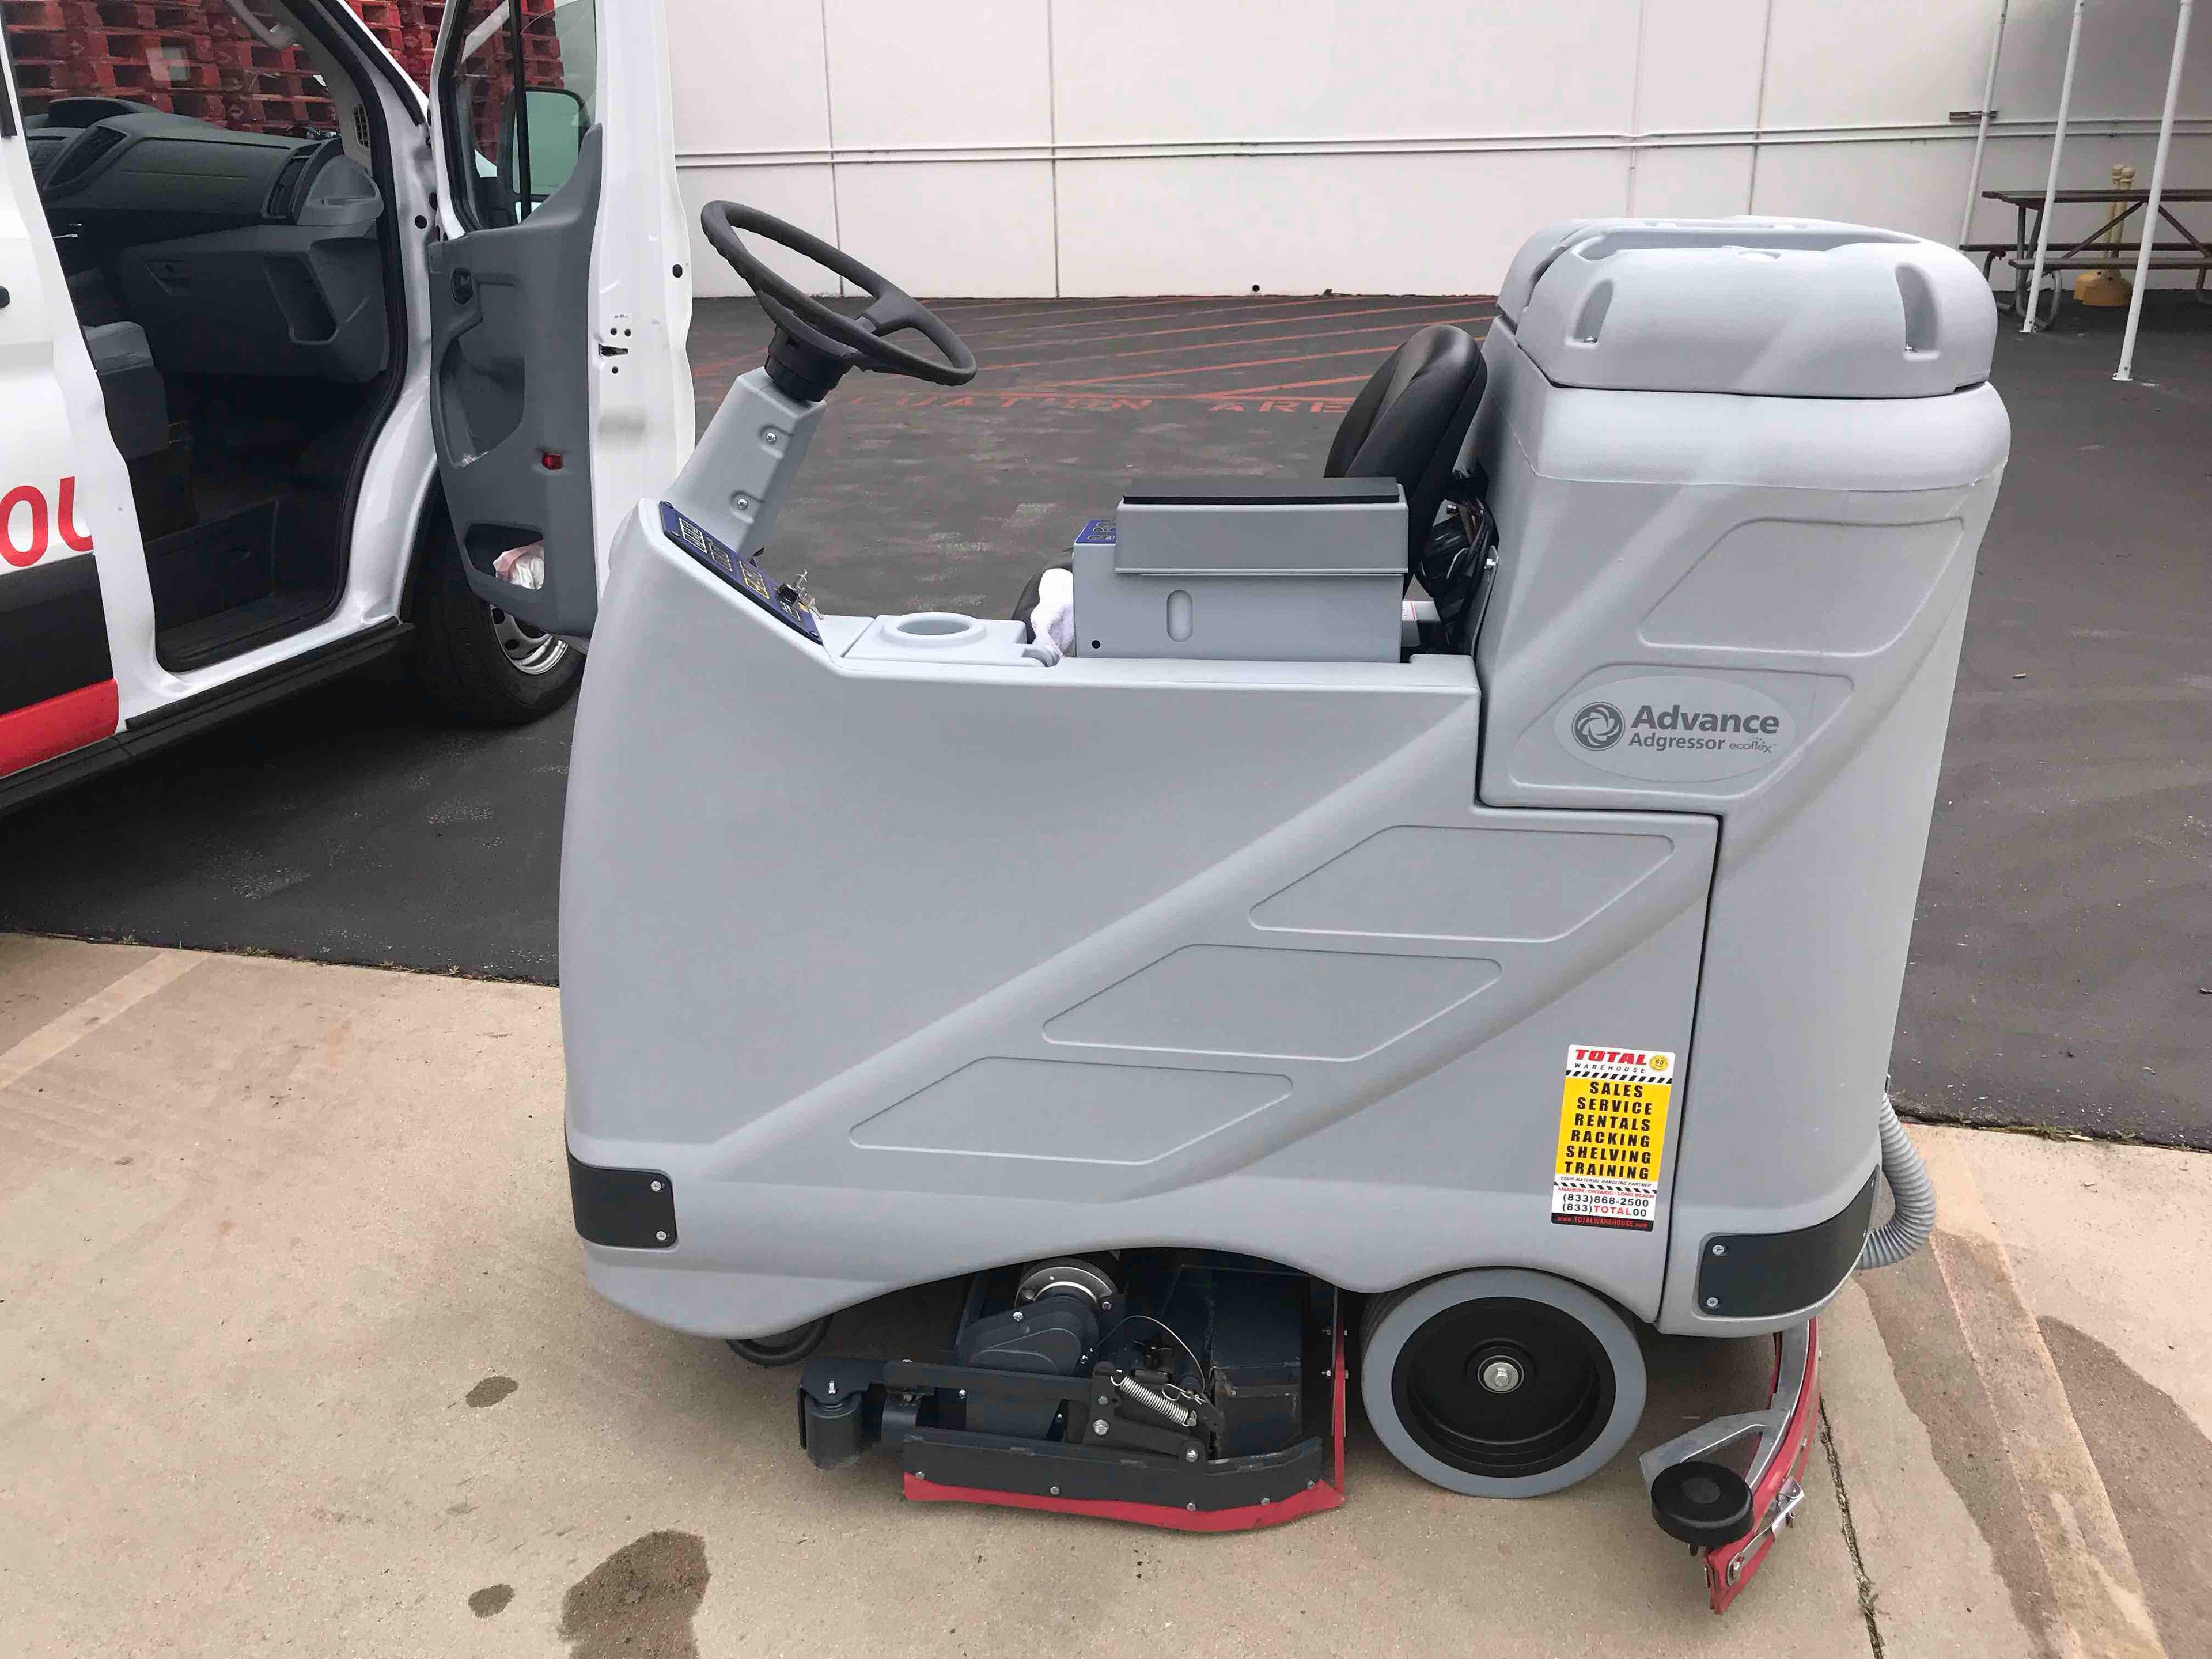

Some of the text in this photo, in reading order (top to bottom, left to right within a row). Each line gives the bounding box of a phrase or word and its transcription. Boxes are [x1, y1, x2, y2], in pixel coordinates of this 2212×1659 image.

[1207, 400, 1352, 413] ARE
[1630, 704, 1779, 734] Advance
[1628, 733, 1772, 753] Adgressor ecoflex
[1575, 1049, 1647, 1065] TOTAL
[1574, 1063, 1646, 1074] WAREHOUSE
[1589, 1081, 1643, 1098] SALES
[1577, 1097, 1653, 1115] SERVICE
[1574, 1113, 1650, 1132] RENTALS
[1571, 1129, 1650, 1148] RACKING
[1566, 1145, 1652, 1164] SHELVING
[1565, 1161, 1649, 1180] TRAINING
[1563, 1193, 1649, 1207] (833)868-2500
